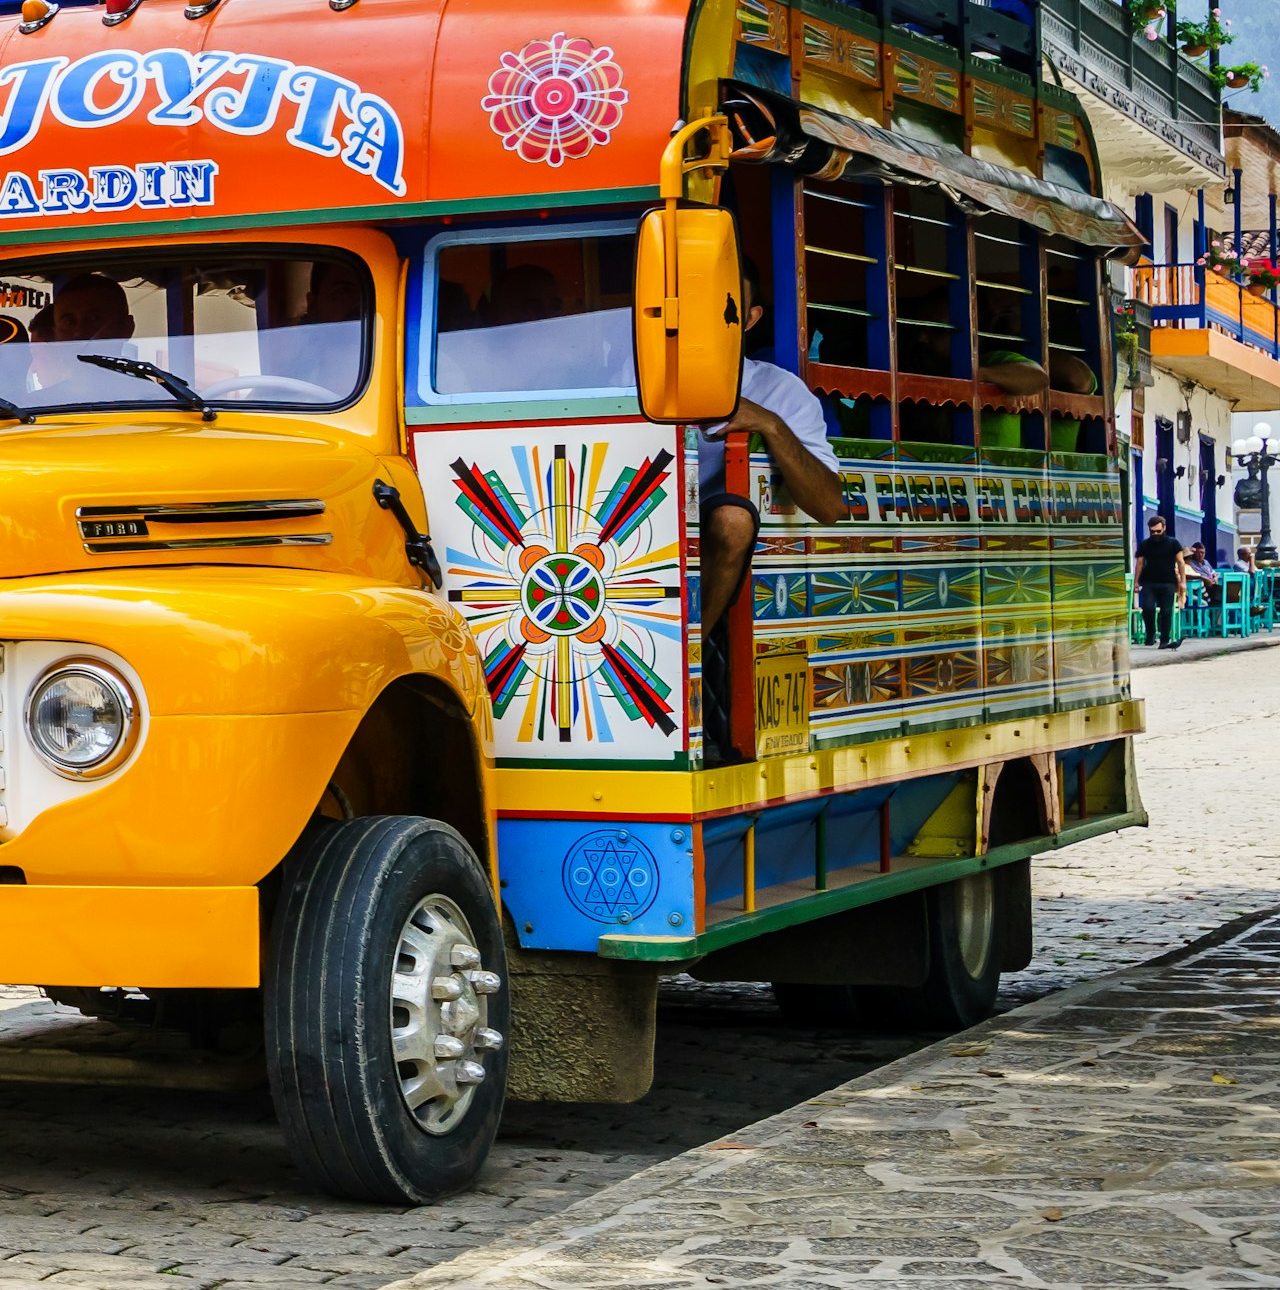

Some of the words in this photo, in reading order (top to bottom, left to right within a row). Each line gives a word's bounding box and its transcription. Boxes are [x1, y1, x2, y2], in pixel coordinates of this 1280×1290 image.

[873, 474, 971, 522] PAISAS
[973, 477, 1009, 523] EN
[94, 521, 138, 536] FORD
